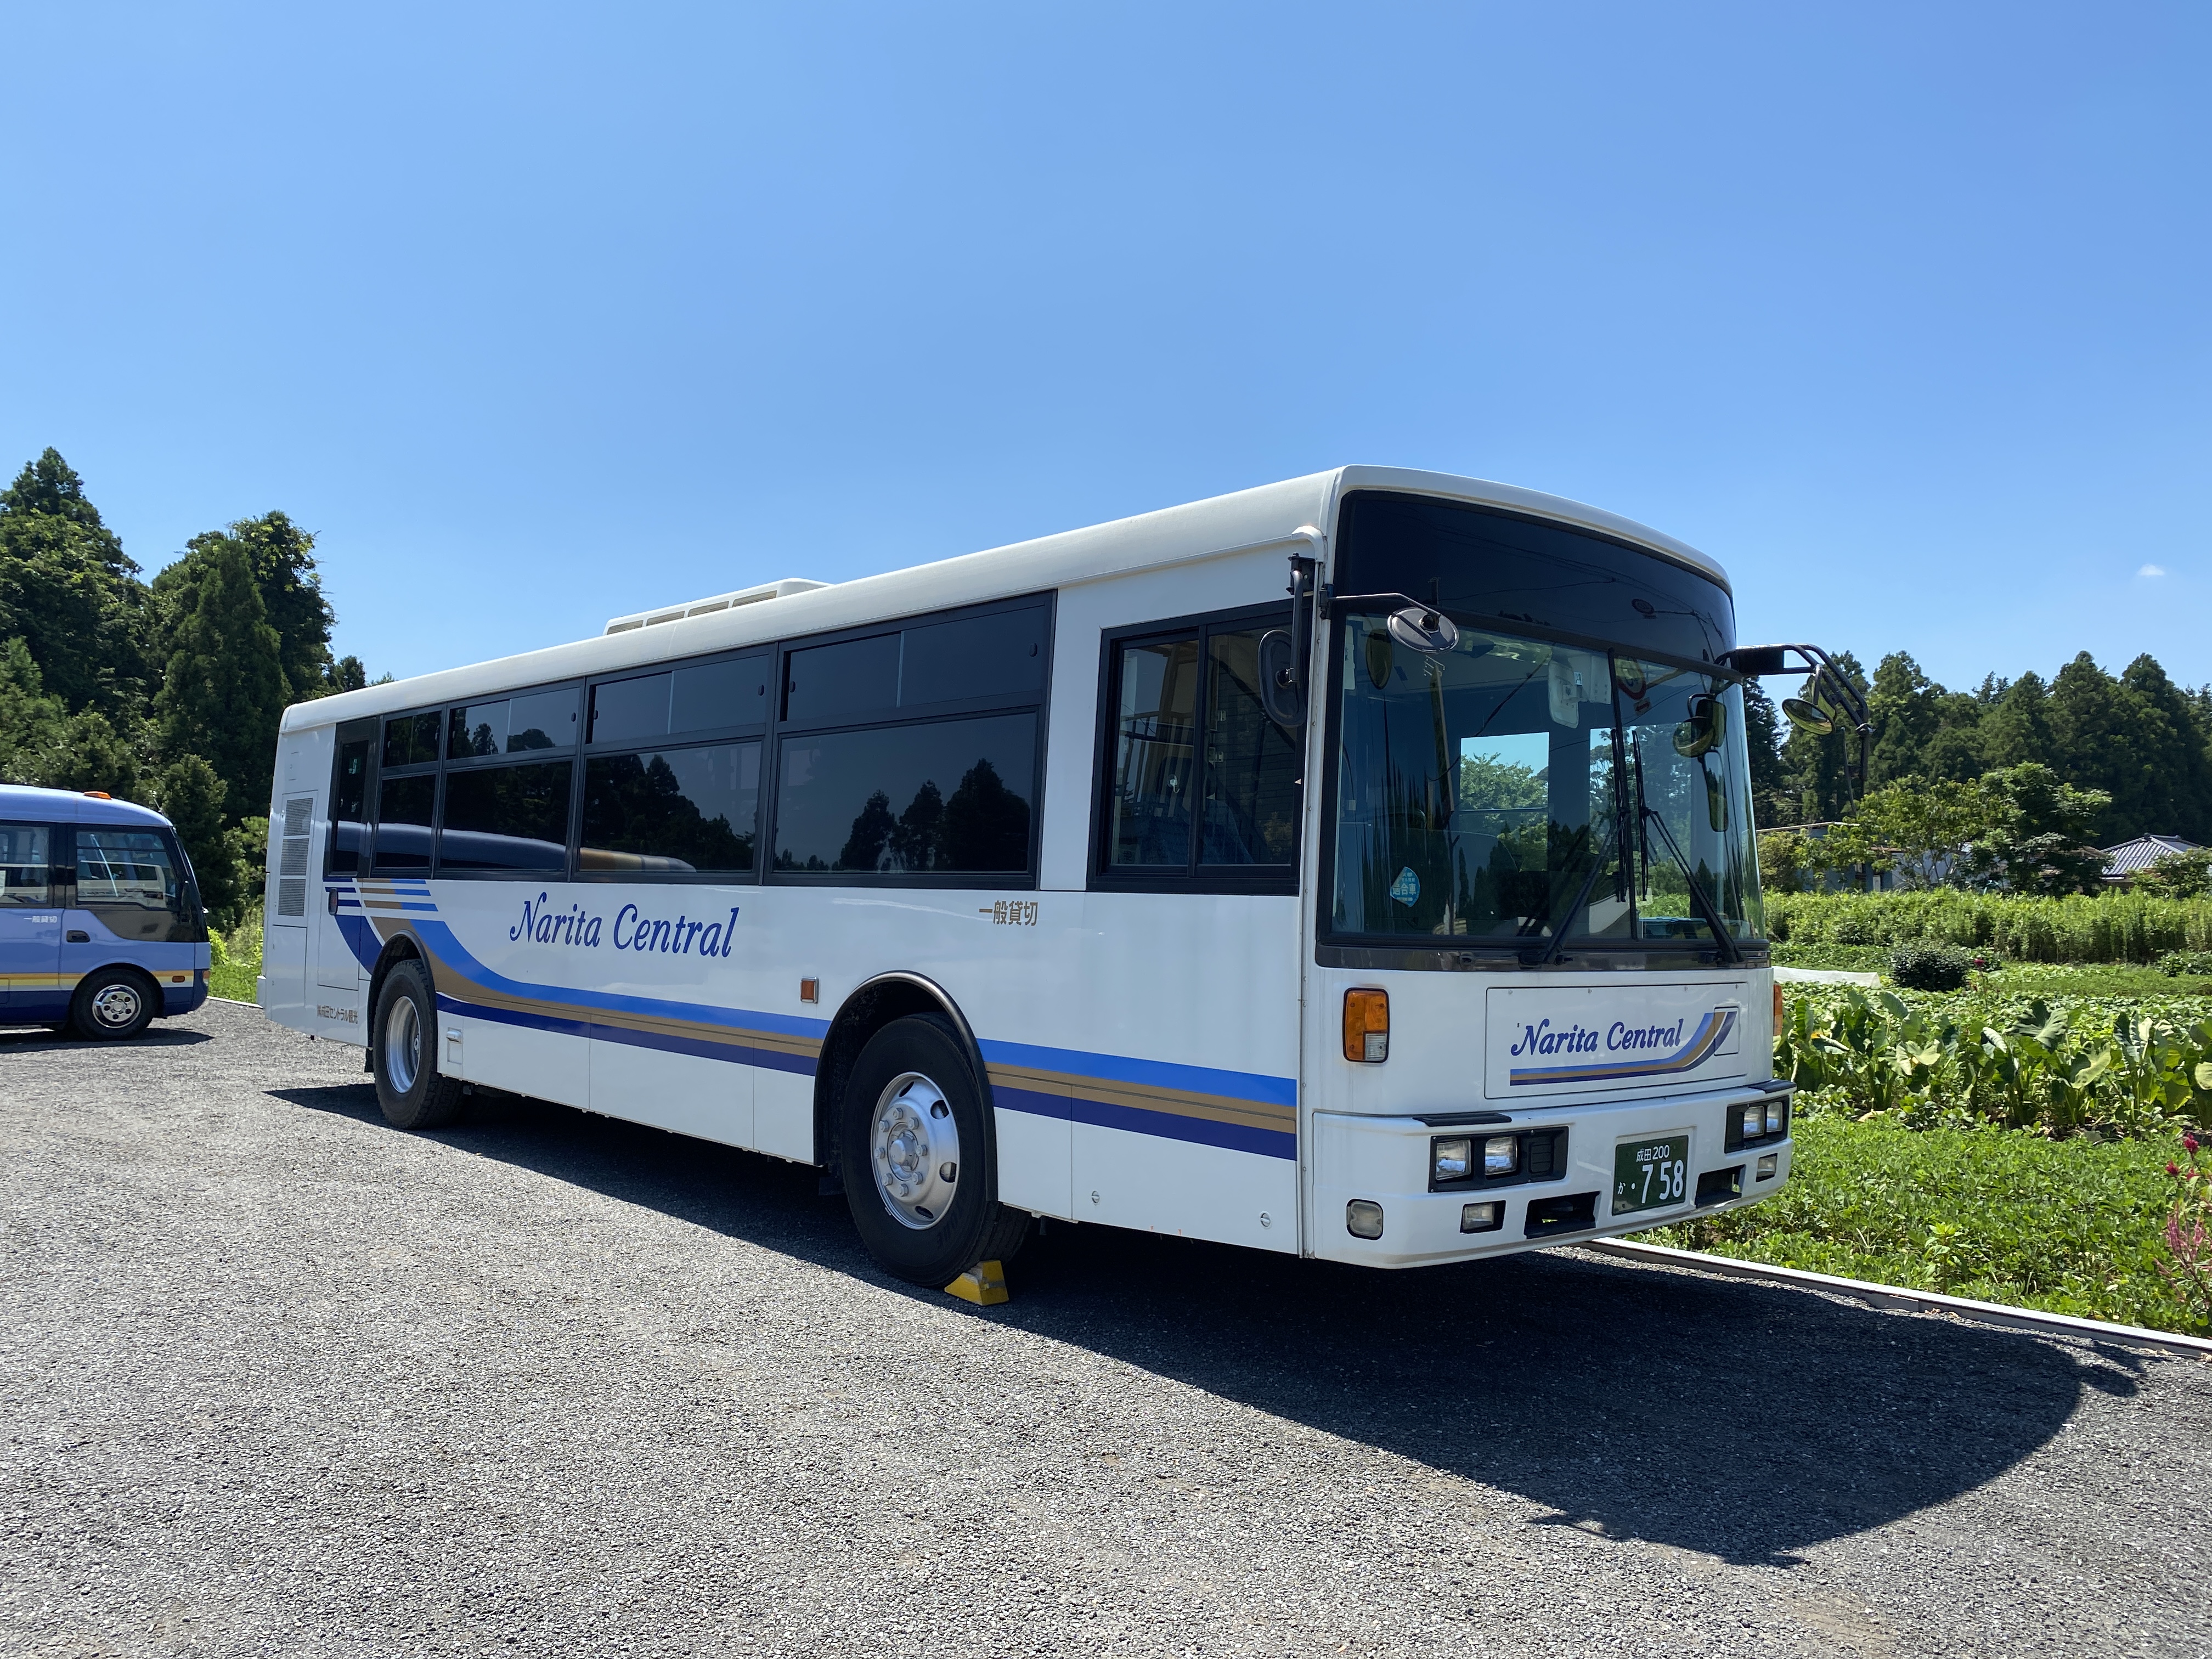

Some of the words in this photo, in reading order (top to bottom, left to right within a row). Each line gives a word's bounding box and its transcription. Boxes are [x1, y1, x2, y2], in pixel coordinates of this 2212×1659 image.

[510, 891, 602, 947] Narita
[613, 904, 740, 957] Central
[979, 900, 1038, 926] 一般貸切
[1511, 1018, 1599, 1056] Narita
[1607, 1018, 1684, 1051] Central
